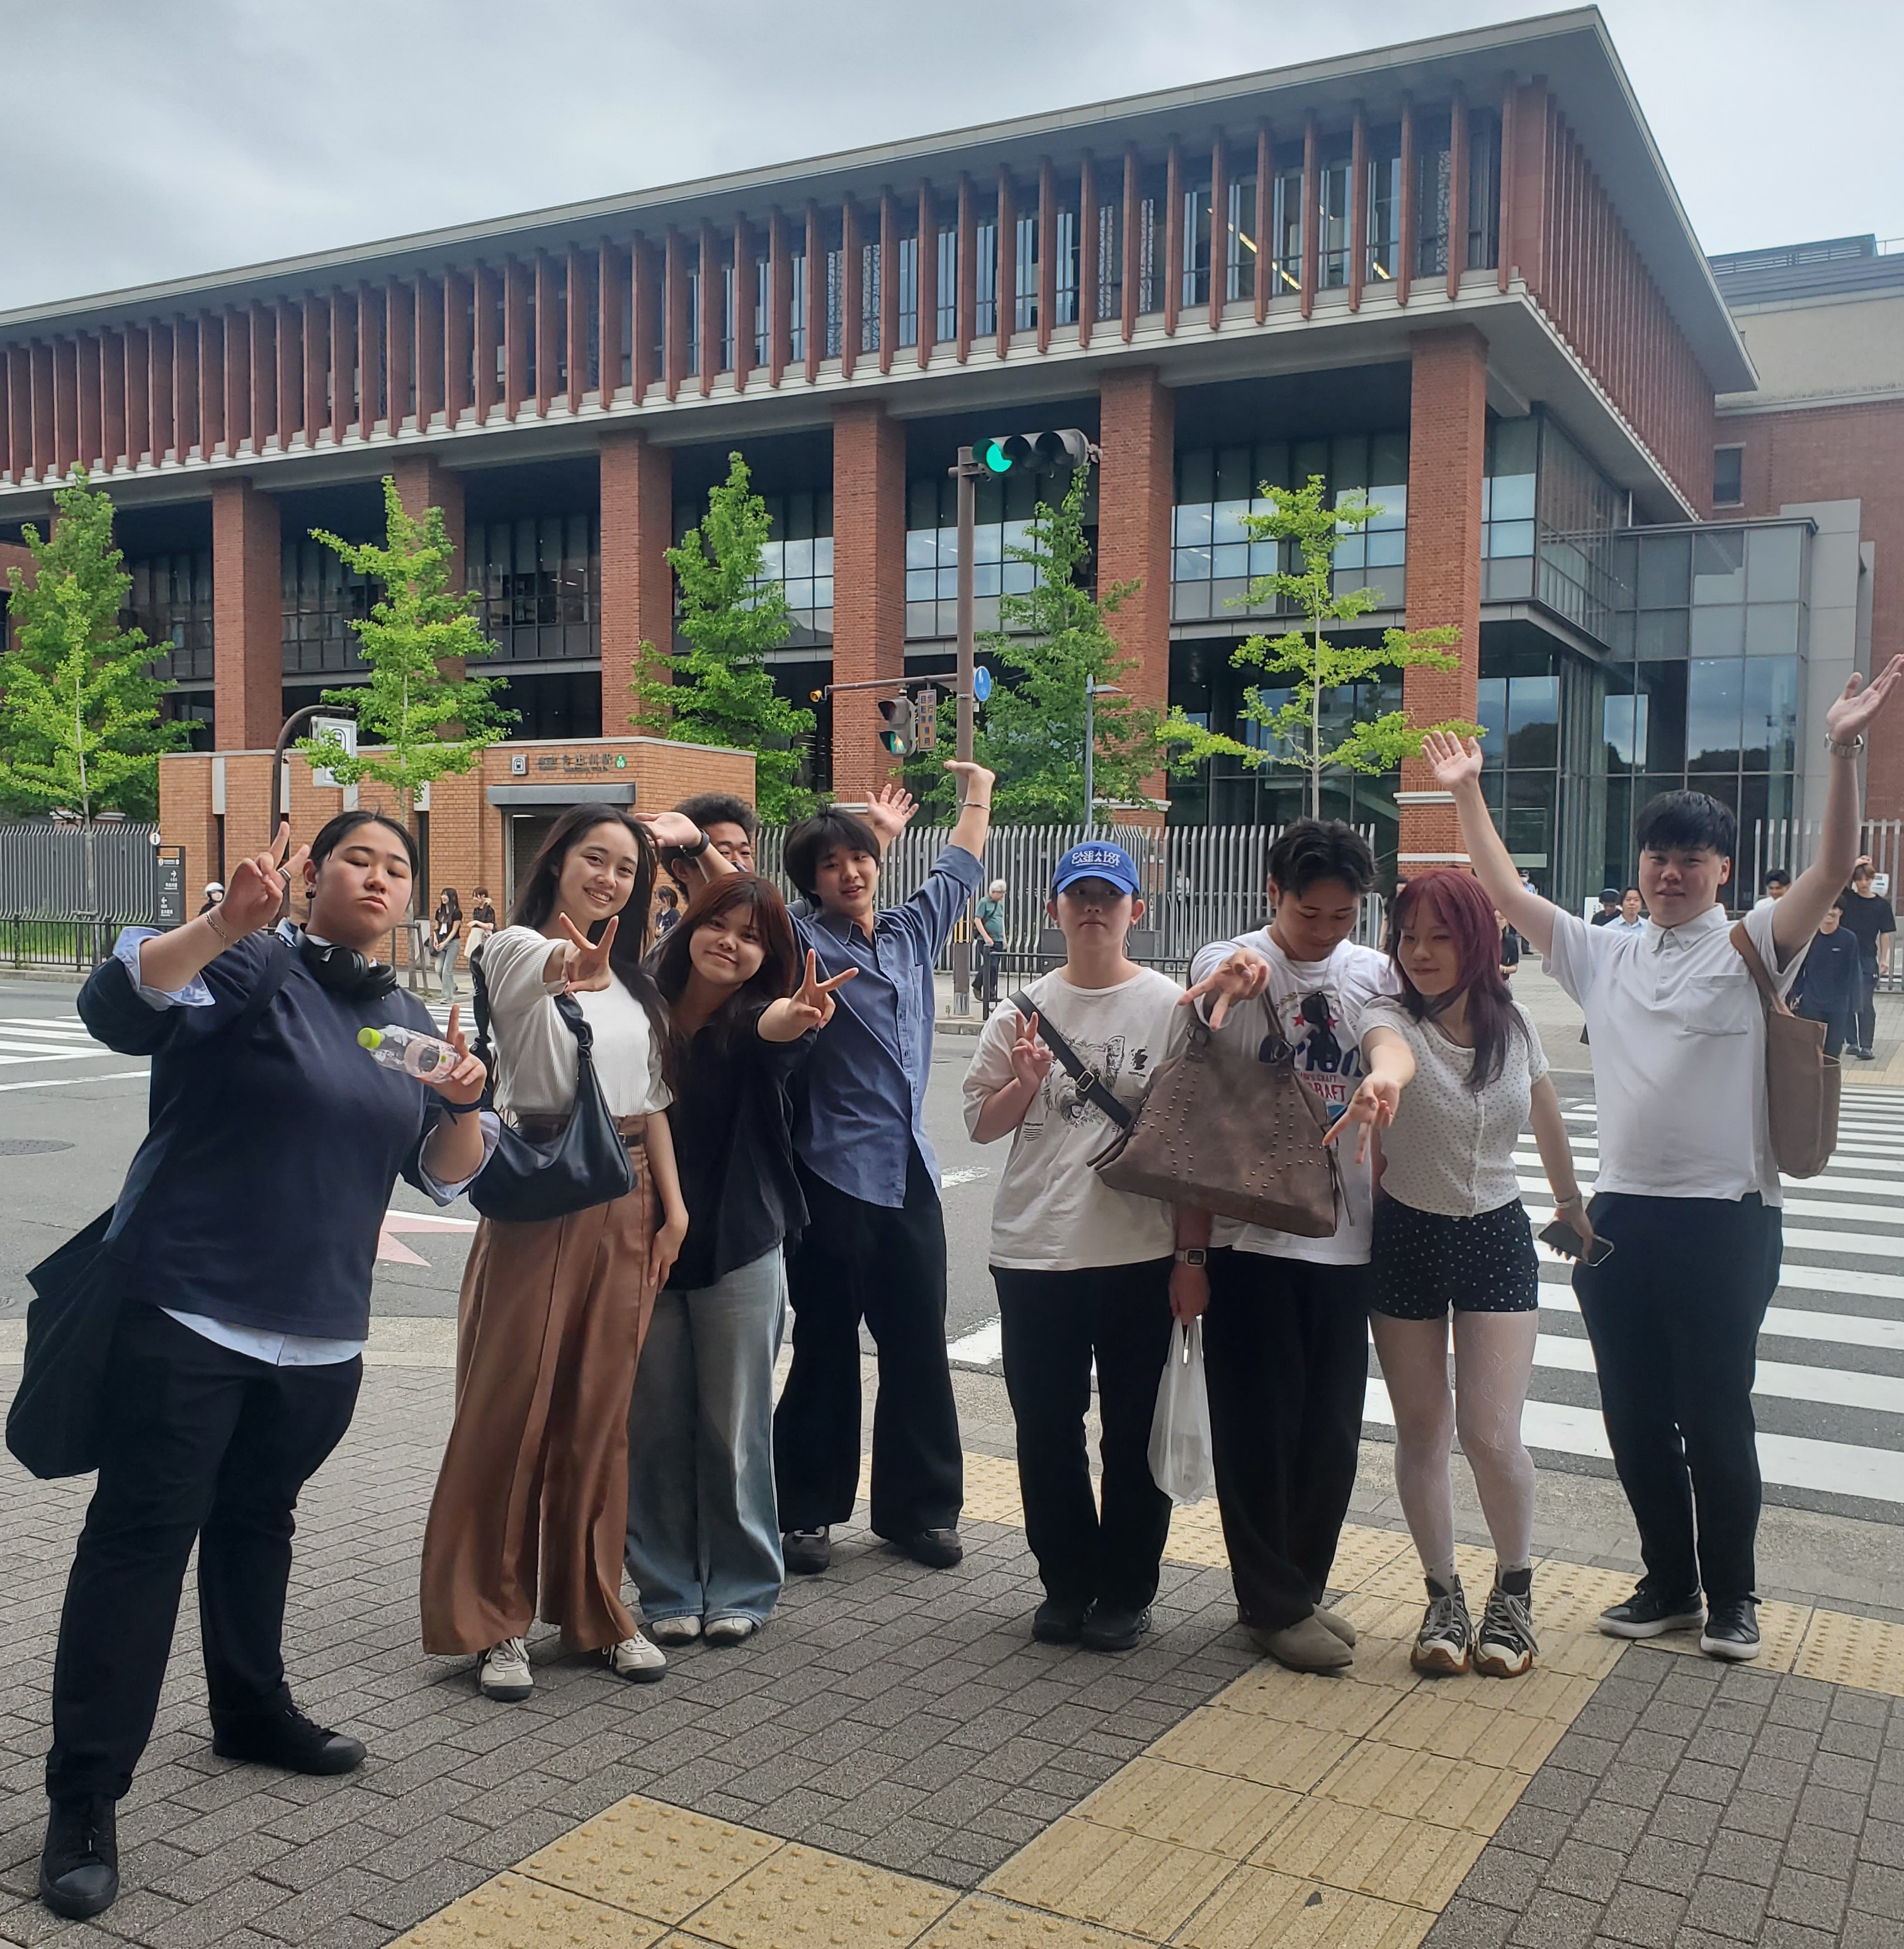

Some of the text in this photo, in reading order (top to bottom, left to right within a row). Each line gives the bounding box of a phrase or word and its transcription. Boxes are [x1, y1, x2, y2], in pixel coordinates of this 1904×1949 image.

[1072, 850, 1094, 859] CASE
[1103, 850, 1120, 860] LOT
[1072, 856, 1094, 864] CASE
[1103, 856, 1120, 866] LOT
[1308, 1082, 1346, 1102] RAFT
